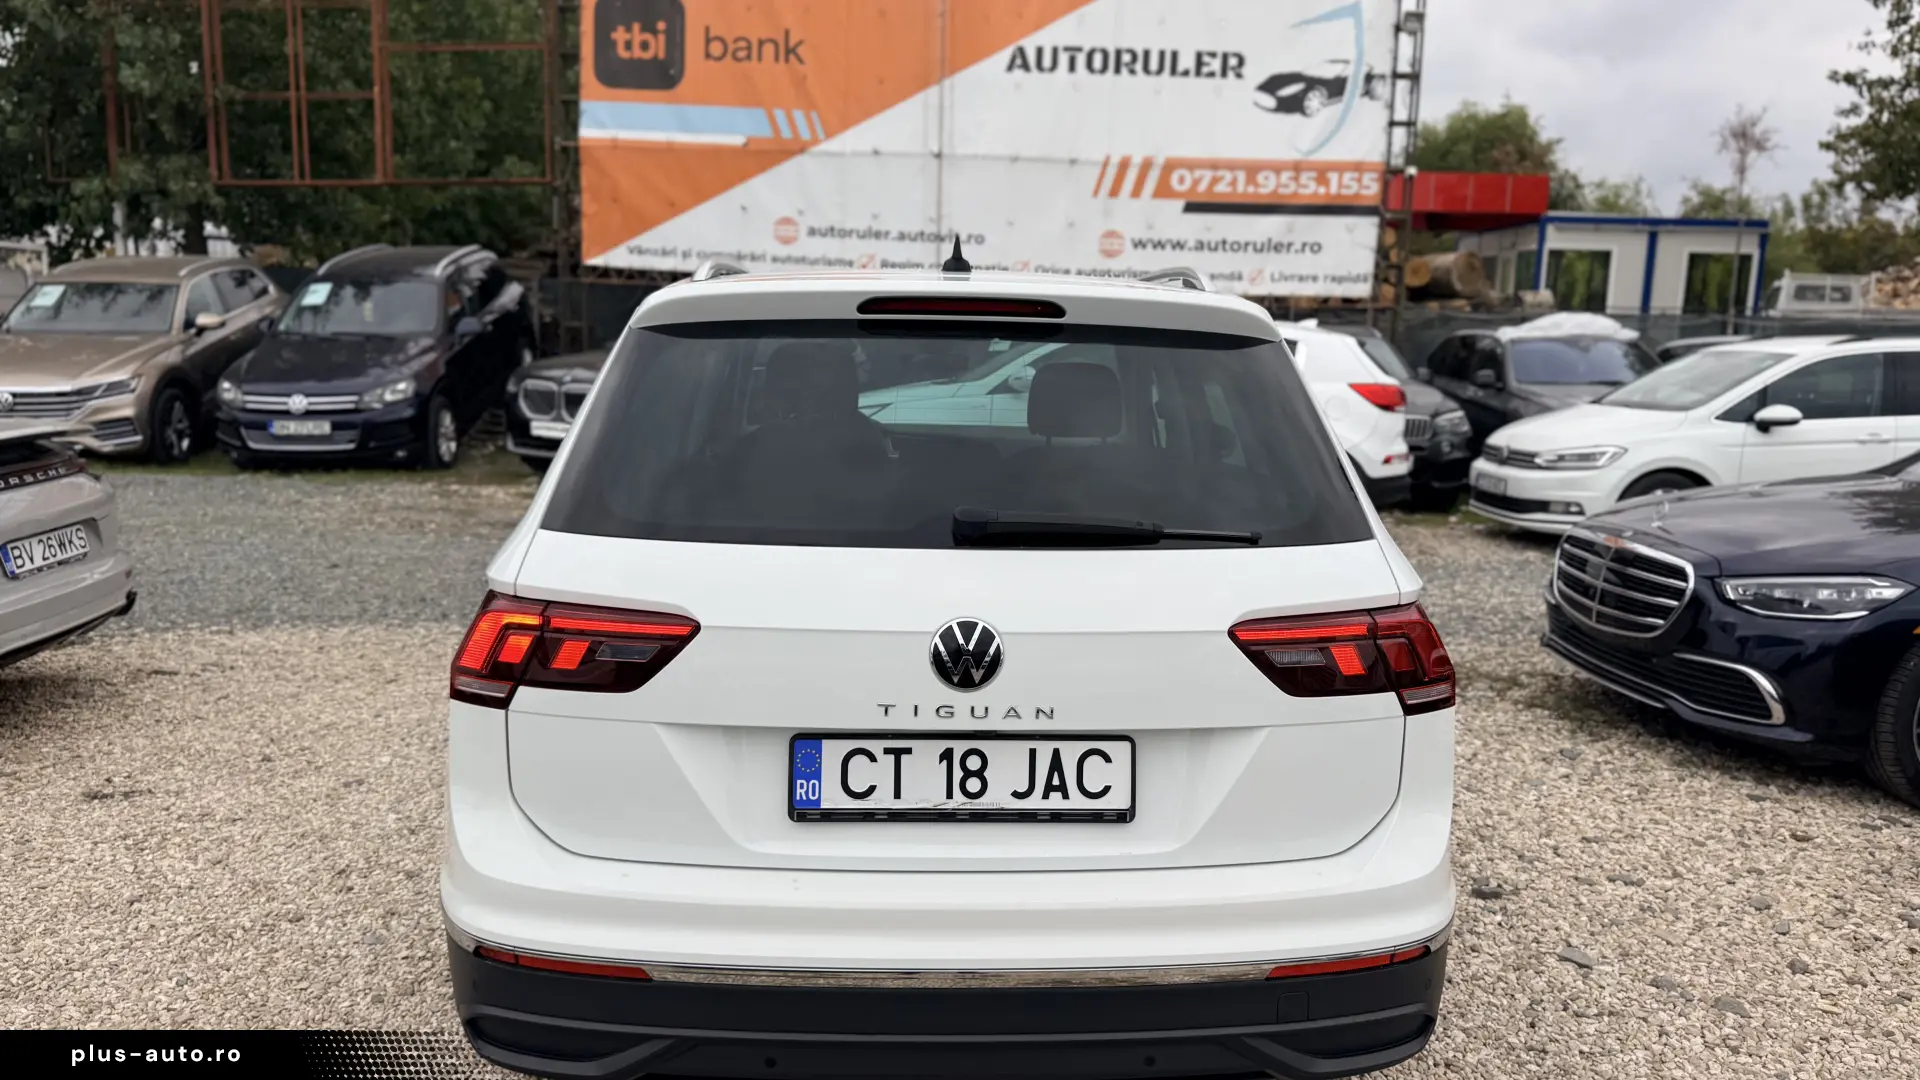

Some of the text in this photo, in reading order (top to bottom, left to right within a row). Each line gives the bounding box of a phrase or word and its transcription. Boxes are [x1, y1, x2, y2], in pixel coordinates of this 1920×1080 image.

[610, 20, 805, 65] tbi bank
[1005, 45, 1247, 80] AUTORULER
[1169, 167, 1380, 197] 0721.955.155
[806, 224, 986, 246] autoruler.autovi.ro
[1131, 237, 1323, 255] www.autoruler.ro
[1270, 271, 1318, 284] Livrare
[10, 542, 34, 569] BV
[877, 703, 1055, 720] TIGUAN
[840, 747, 1113, 800] CT 18 JAC
[796, 779, 820, 801] RO
